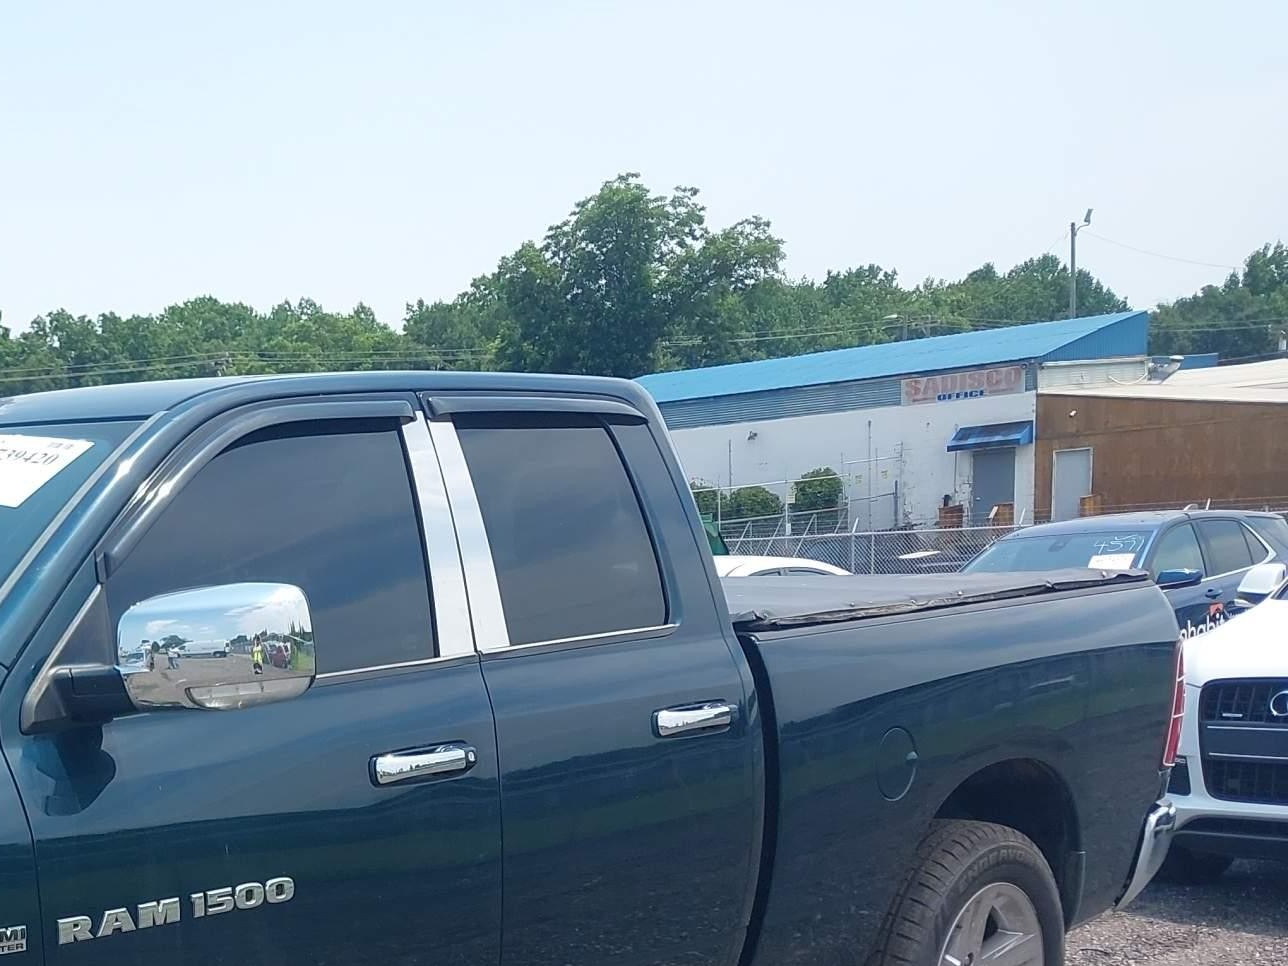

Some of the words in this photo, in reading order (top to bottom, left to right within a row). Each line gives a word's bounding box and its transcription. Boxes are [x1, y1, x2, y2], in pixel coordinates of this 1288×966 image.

[904, 366, 1023, 397] SADISCO
[57, 897, 182, 945] RAM
[190, 876, 295, 918] 1500
